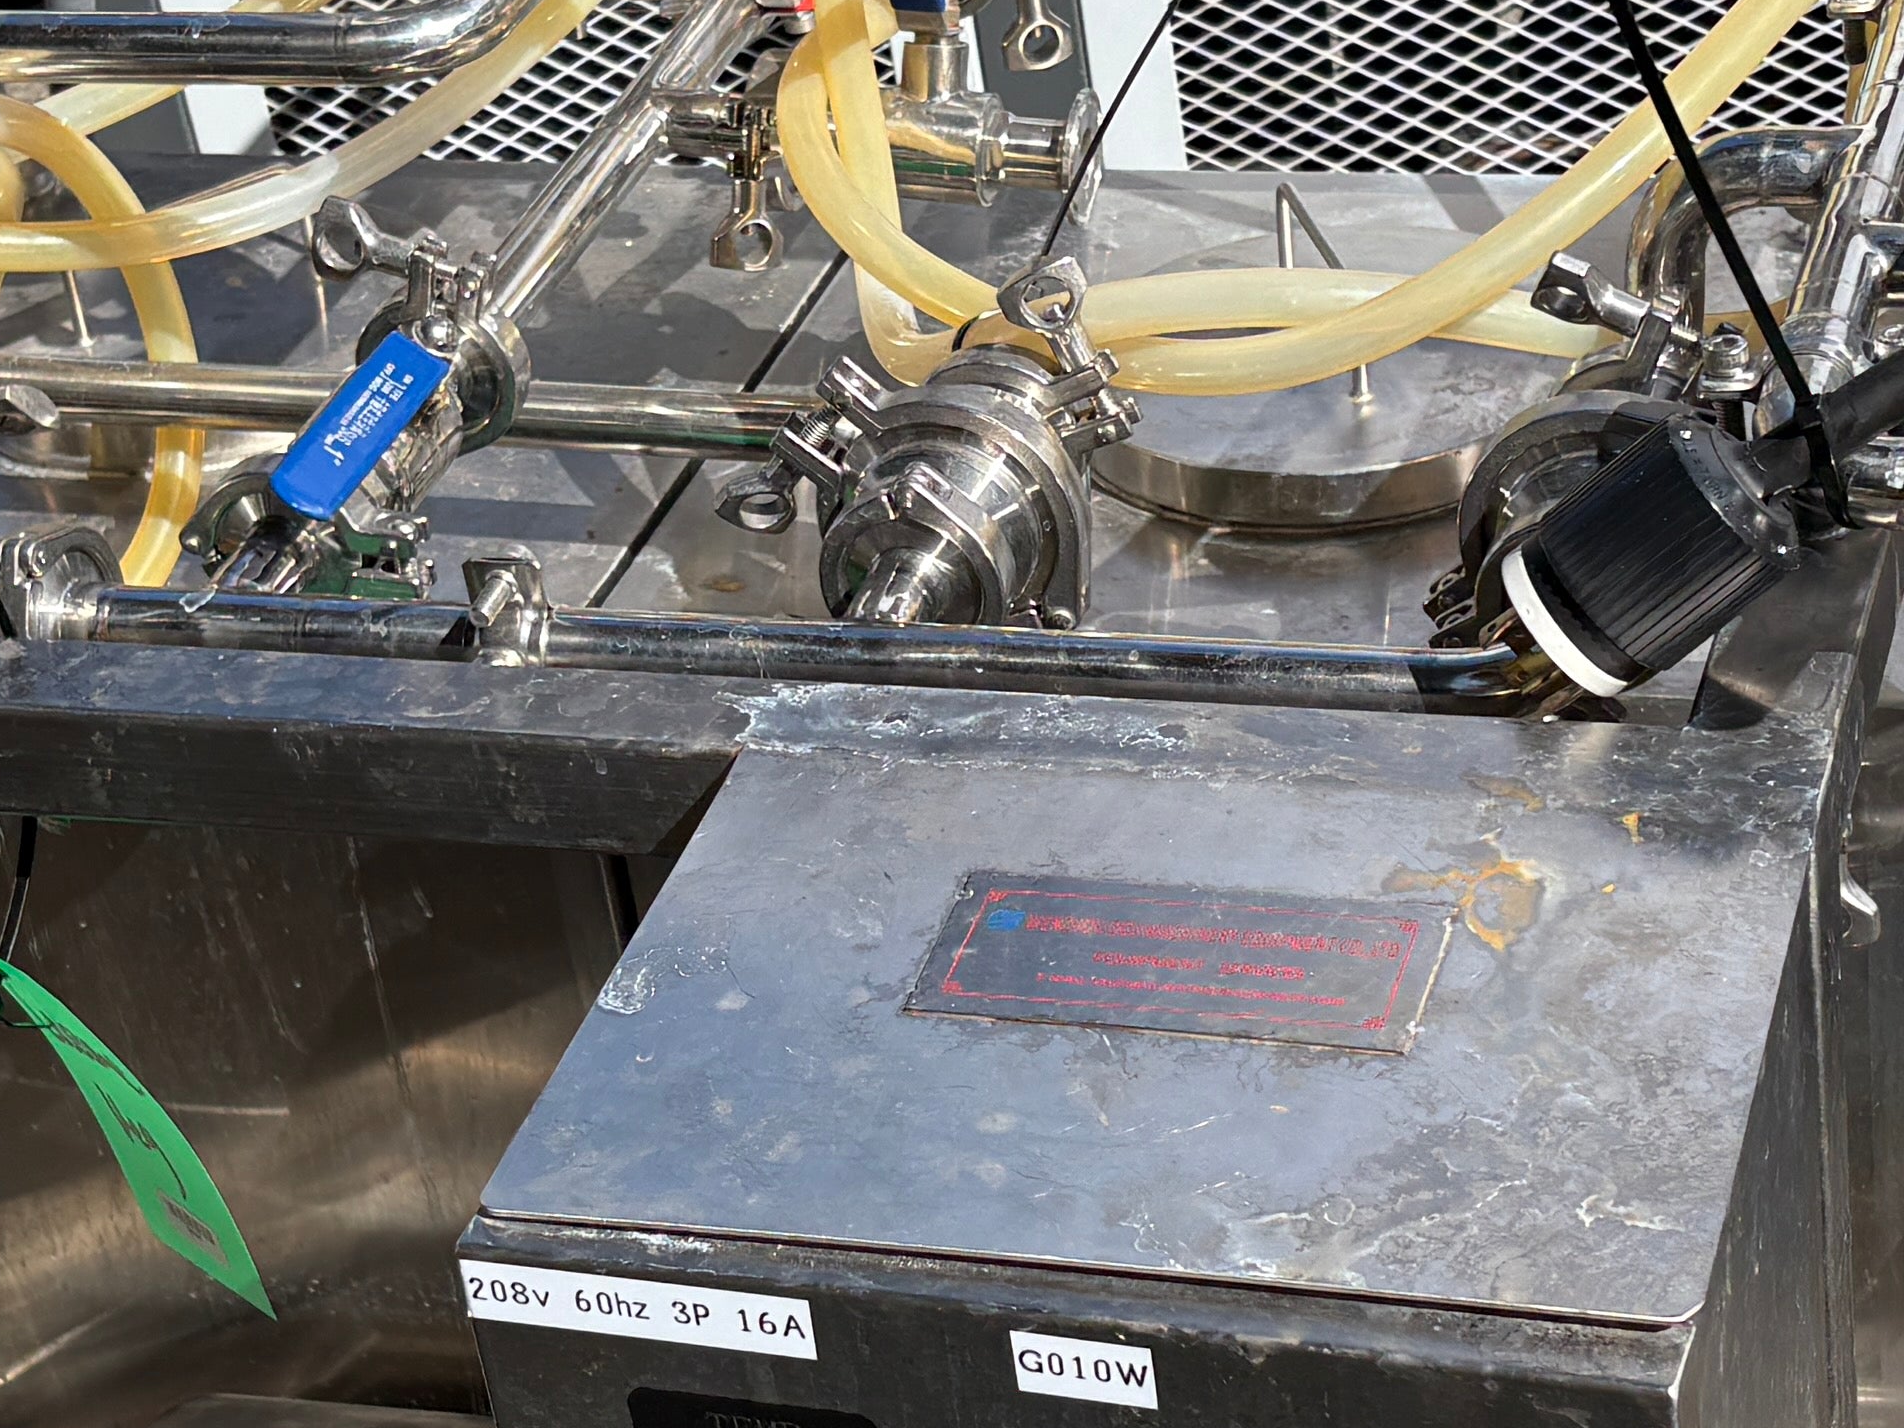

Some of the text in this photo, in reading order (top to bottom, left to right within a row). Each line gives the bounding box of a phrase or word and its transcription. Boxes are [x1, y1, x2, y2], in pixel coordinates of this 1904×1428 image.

[468, 1277, 806, 1340] 208v 60hz 3P 16A
[1018, 1349, 1148, 1388] G010W
